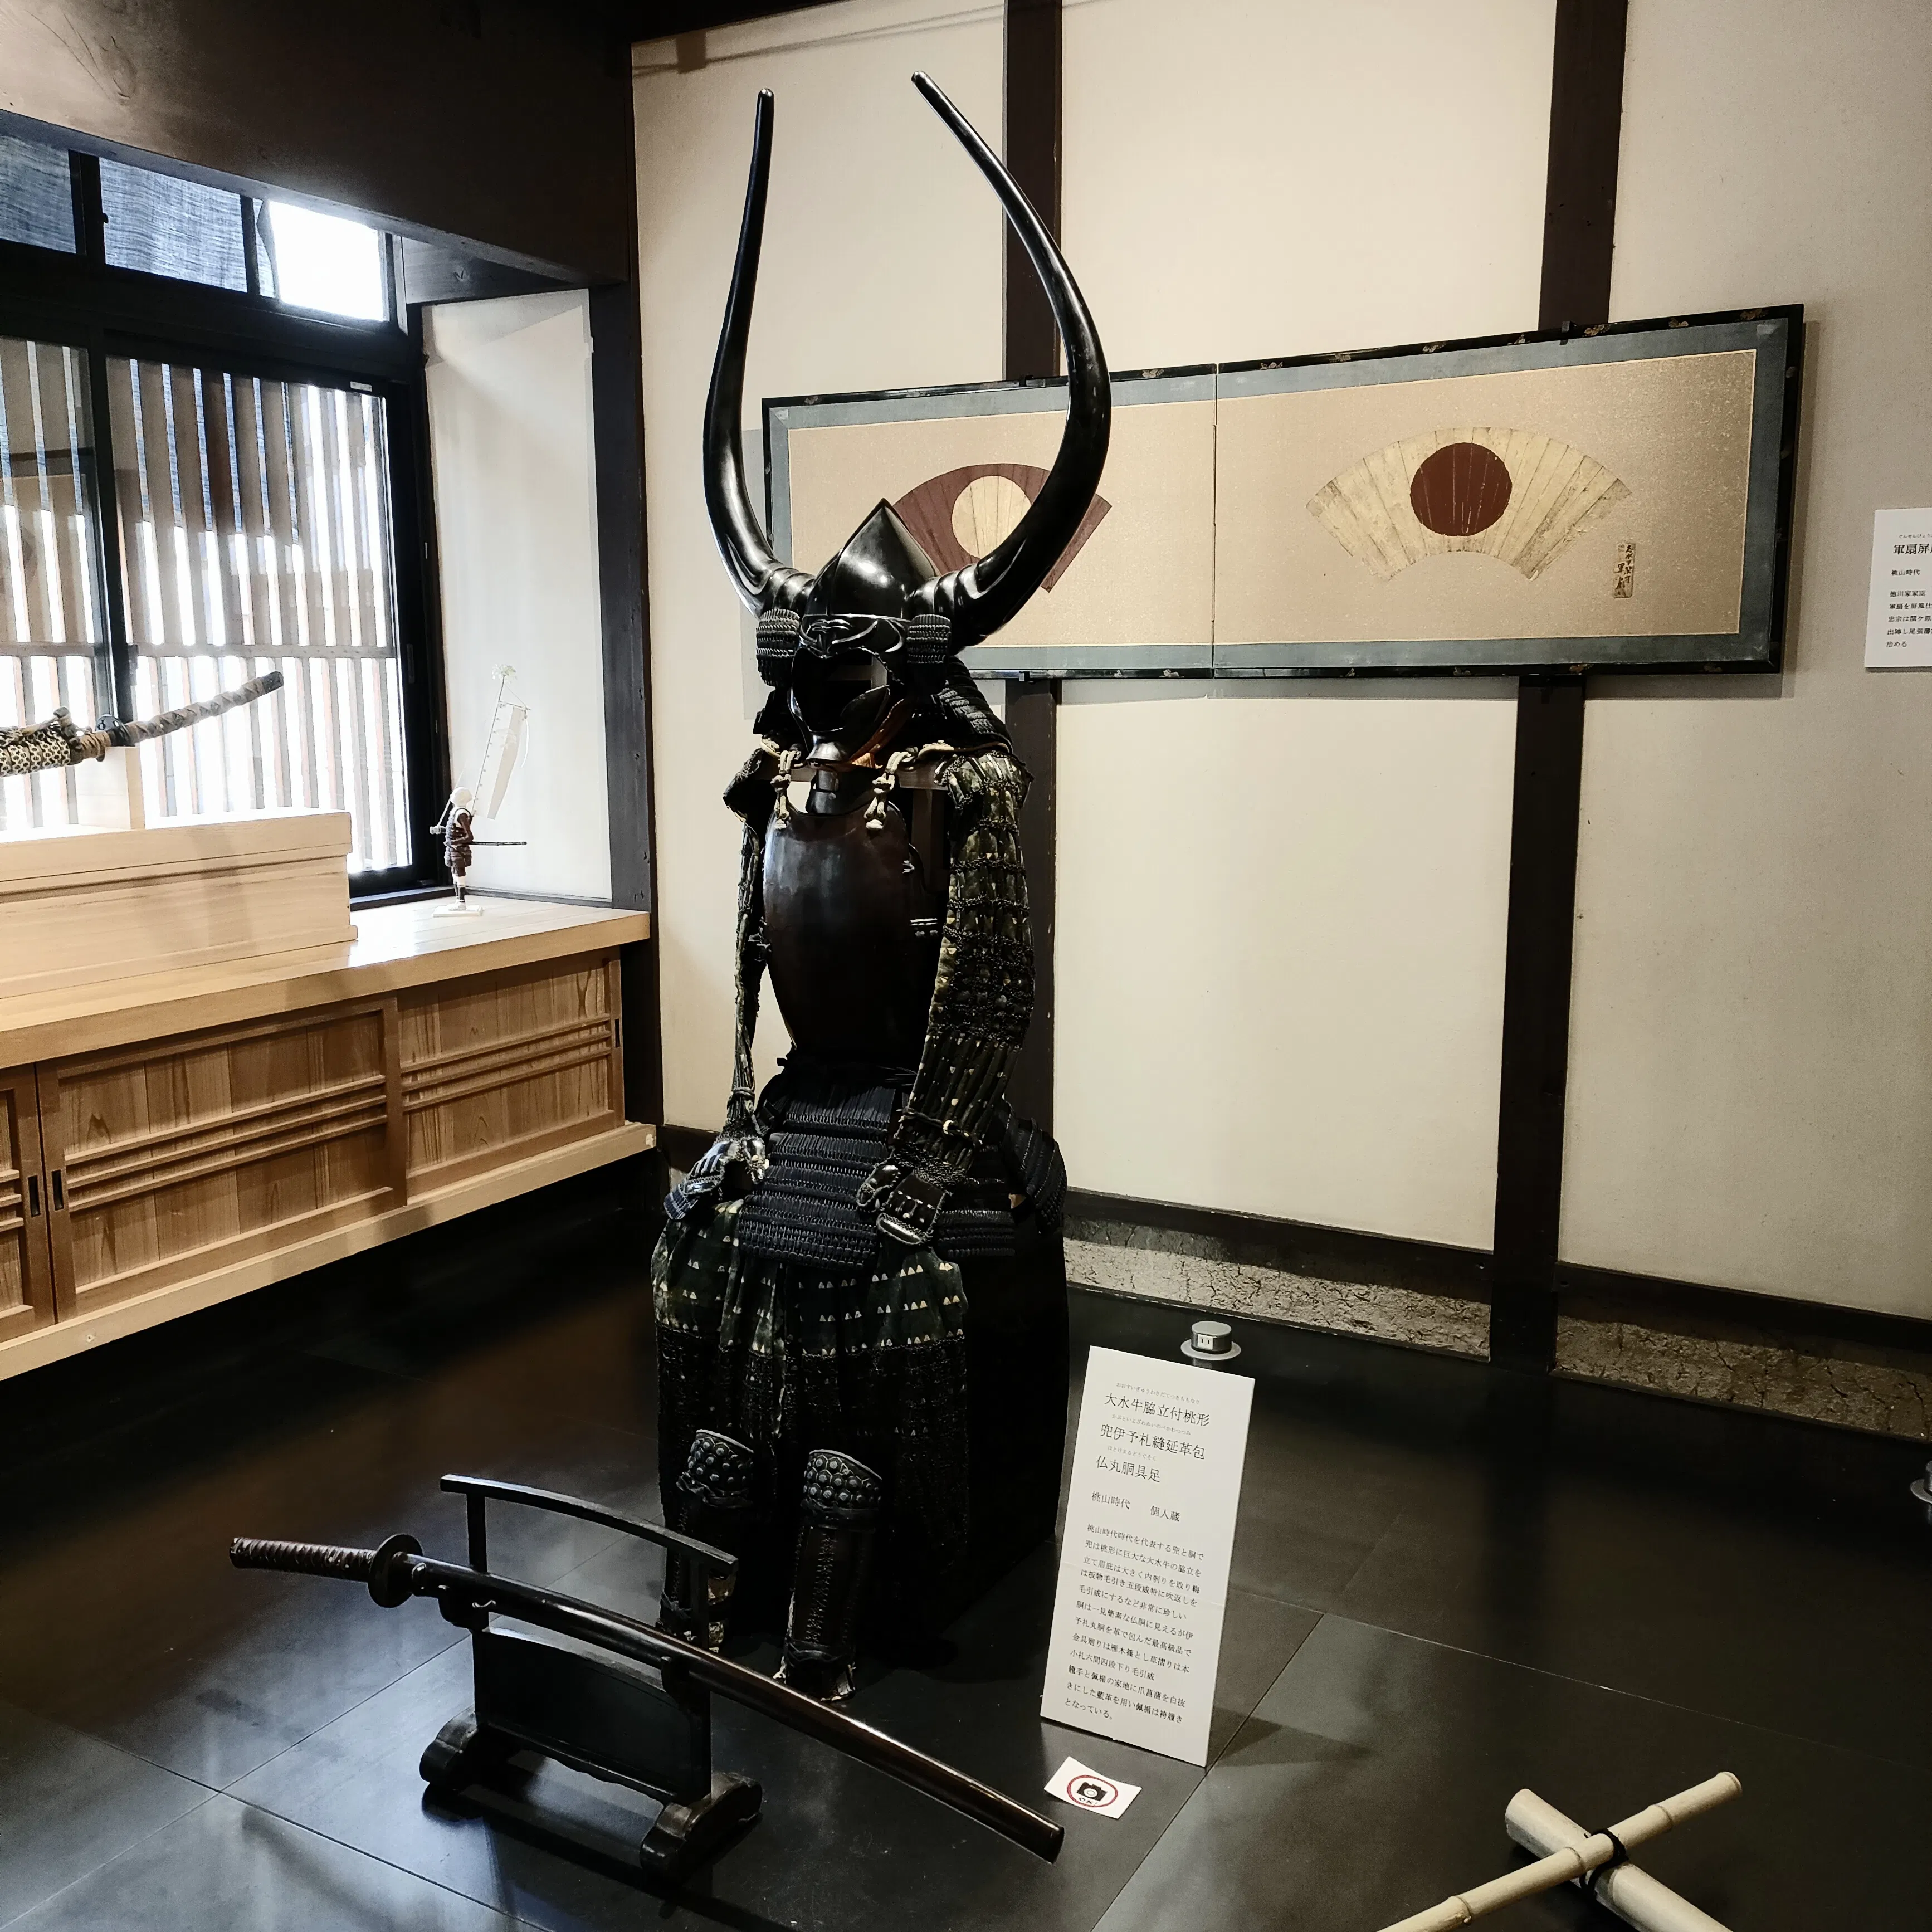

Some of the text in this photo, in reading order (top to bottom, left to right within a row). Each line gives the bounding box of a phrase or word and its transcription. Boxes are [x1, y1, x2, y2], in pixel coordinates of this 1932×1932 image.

[1893, 543, 1932, 554] 軍扇屏
[1104, 1392, 1210, 1427] 大水牛脇立付桃形
[1100, 1424, 1204, 1460] 兜伊予札縫延革包
[1096, 1455, 1160, 1483] 仏丸胴具足
[1091, 1491, 1180, 1522] 桃山時代 個人蔵
[1085, 1540, 1202, 1578] 兜は桃形に巨大な大水牛の脇立を
[1087, 1523, 1204, 1561] 桃山時代時代を代表する兜と胴で
[1079, 1585, 1187, 1619] 毛引威にするなど非常に珍しい
[1075, 1617, 1192, 1657] 予札丸胴を革で包んだ最高級品で
[1076, 1600, 1194, 1640] 胴は一見簡素な仏胴に見えるが伊
[1065, 1697, 1113, 1720] となっている。
